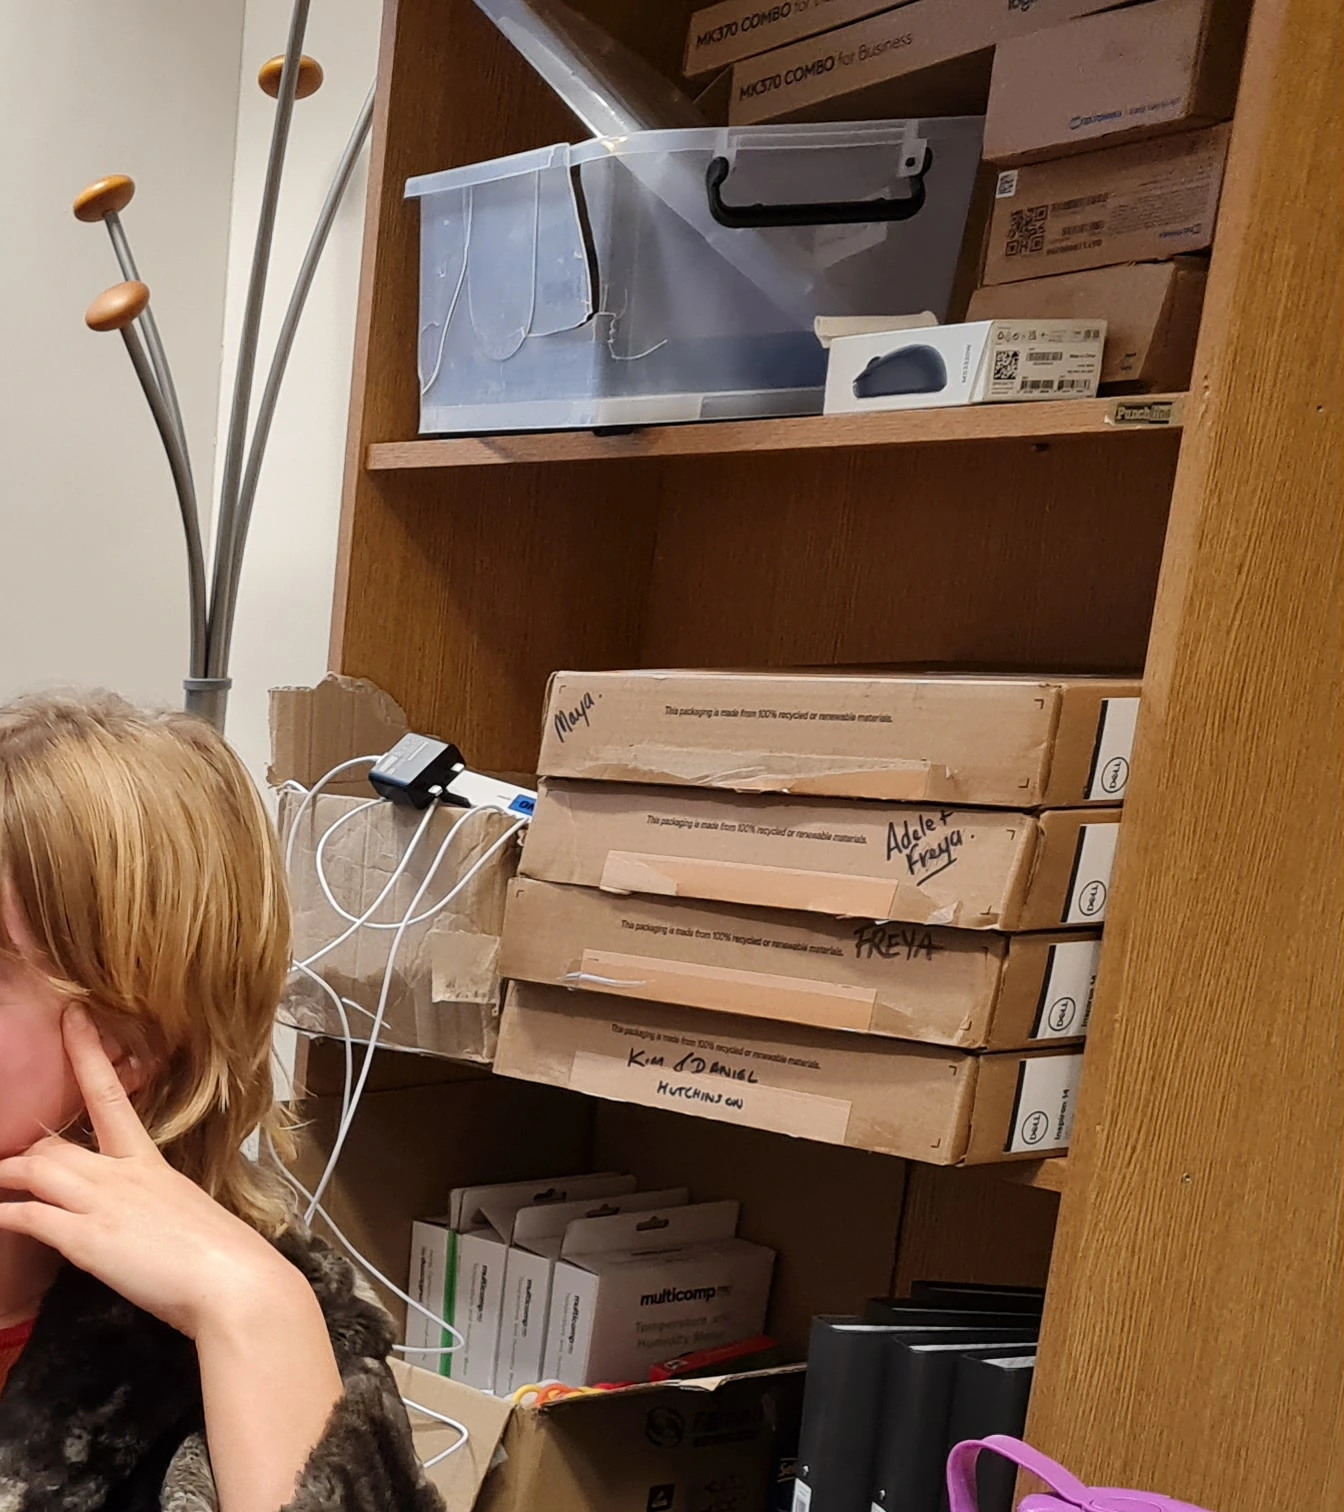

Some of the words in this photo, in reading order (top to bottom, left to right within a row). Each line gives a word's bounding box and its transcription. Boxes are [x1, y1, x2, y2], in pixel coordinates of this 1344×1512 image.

[696, 20, 739, 48] MK370
[741, 2, 792, 31] COMBO
[739, 74, 781, 101] MK370
[784, 56, 835, 85] COMBO
[837, 51, 855, 66] for
[857, 32, 913, 61] Business
[665, 705, 678, 715] This
[679, 708, 712, 718] packaging
[721, 709, 739, 717] made
[740, 709, 756, 718] from
[758, 710, 777, 719] 100%
[778, 711, 808, 721] recycled
[809, 712, 818, 720] or
[819, 713, 856, 722] renewable
[647, 815, 660, 825] This
[661, 817, 692, 829] packaging
[701, 820, 719, 830] made
[720, 822, 736, 832] from
[737, 823, 756, 834] 100%
[757, 825, 786, 837] recycled
[787, 829, 795, 837] or
[796, 830, 832, 841] renewable
[887, 814, 936, 861] Adele
[622, 919, 634, 930] This
[635, 922, 667, 935] packaging
[675, 927, 693, 937] made
[695, 929, 711, 939] from
[712, 931, 731, 942] 100%
[732, 934, 761, 946] recycled
[762, 938, 771, 947] or
[772, 939, 807, 951] renewable
[854, 928, 944, 961] FREYA
[612, 1023, 623, 1034] This
[624, 1026, 655, 1040] packaging
[662, 1034, 680, 1044] made
[681, 1035, 696, 1047] from
[697, 1039, 714, 1050] 100%
[716, 1043, 743, 1055] recycled
[744, 1048, 752, 1057] or
[753, 1050, 787, 1064] renewable
[657, 1080, 743, 1110] HUTCHINSON
[1054, 1101, 1068, 1140] Inspiron
[1062, 1089, 1069, 1099] 14
[477, 1265, 488, 1312] multicomp
[522, 1279, 533, 1327] multicomp
[640, 1286, 716, 1306] multicomp
[568, 1295, 580, 1343] multicomp
